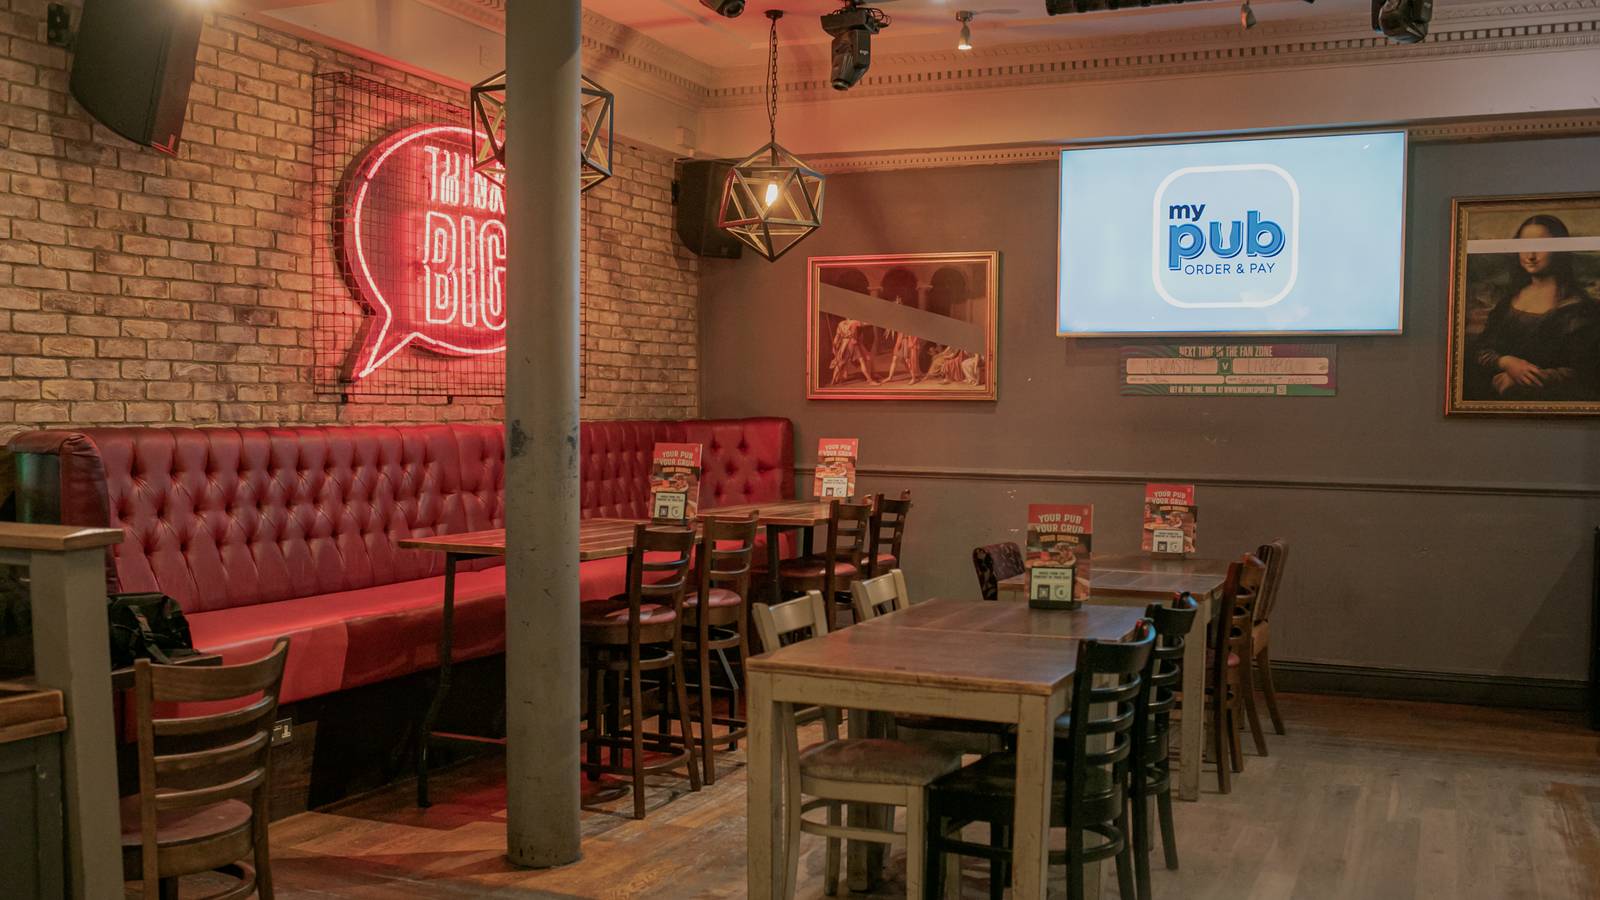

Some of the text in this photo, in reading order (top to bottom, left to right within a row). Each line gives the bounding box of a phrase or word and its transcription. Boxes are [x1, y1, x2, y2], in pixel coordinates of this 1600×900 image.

[1168, 204, 1206, 222] my
[1168, 210, 1286, 271] pub
[422, 210, 507, 331] BIG
[1184, 262, 1276, 275] ORDER & PAY
[1179, 345, 1197, 357] NEXT
[1198, 345, 1214, 357] TIME
[1226, 345, 1239, 357] THE
[1240, 345, 1254, 357] FAN
[1255, 345, 1273, 357] ZONE
[1037, 513, 1082, 525] YOUR PUB
[1035, 523, 1058, 533] YOUR
